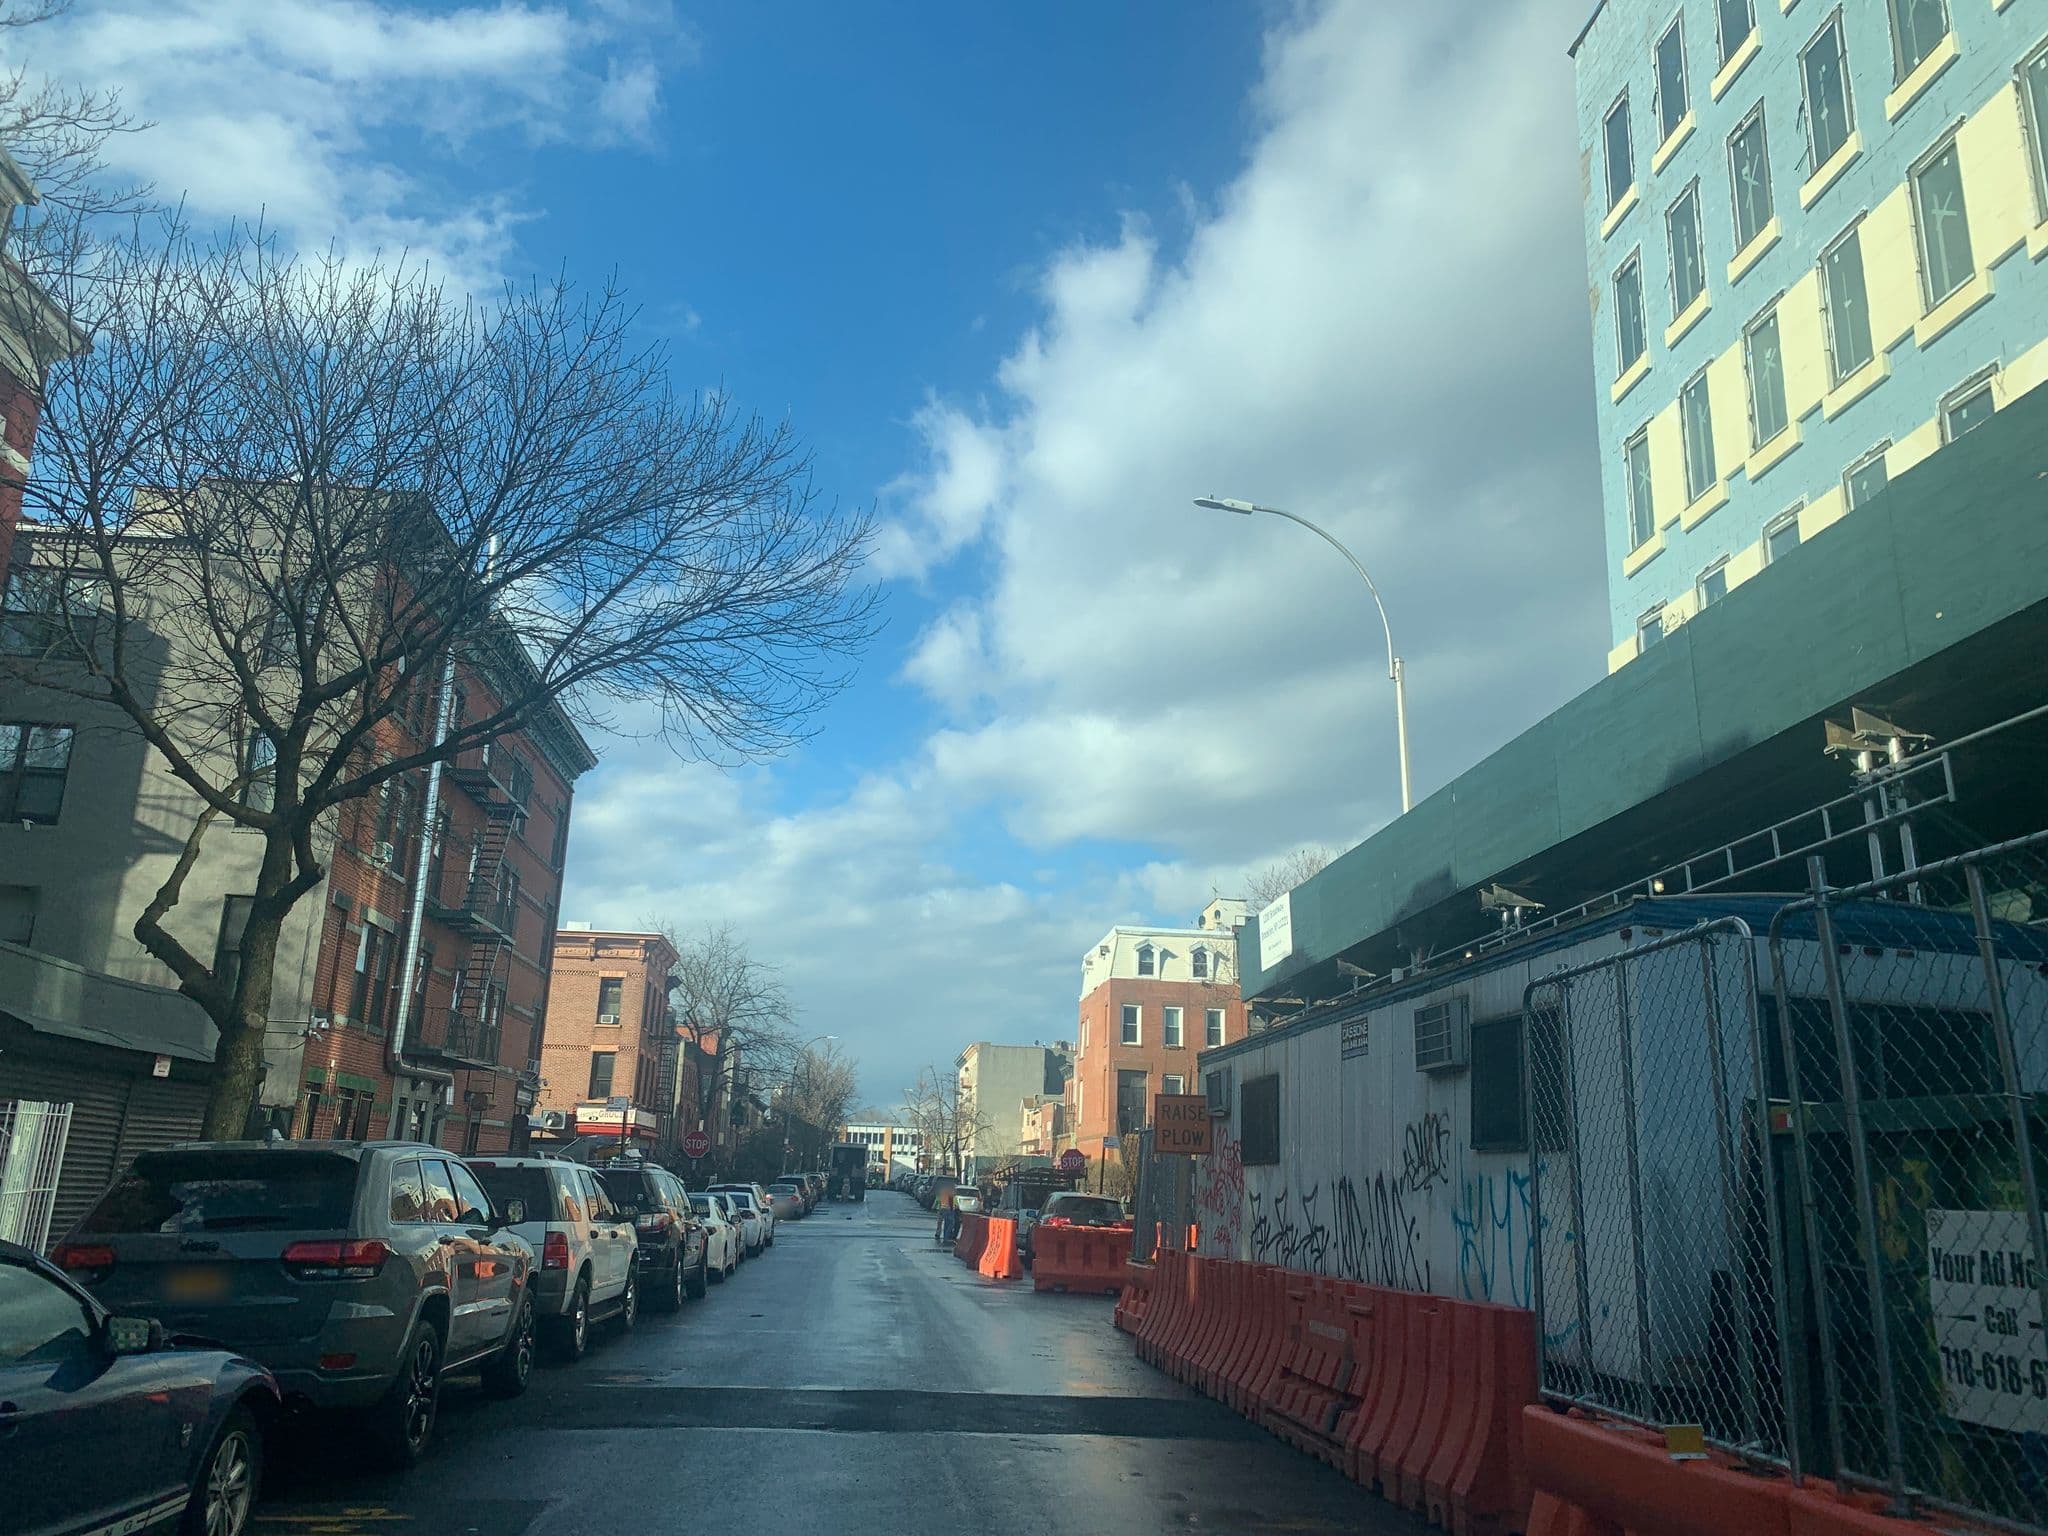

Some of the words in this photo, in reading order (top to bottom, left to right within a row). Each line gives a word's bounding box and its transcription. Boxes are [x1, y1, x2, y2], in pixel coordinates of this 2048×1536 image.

[1161, 1104, 1206, 1122] RAISE
[685, 1139, 708, 1150] STOP
[1162, 1129, 1205, 1146] PLOW
[1062, 1156, 1085, 1168] STOP
[1931, 1247, 1976, 1284] Your
[1980, 1250, 2007, 1287] Ad
[1985, 1305, 2019, 1337] Call
[1940, 1346, 2048, 1400] 718-618-6
